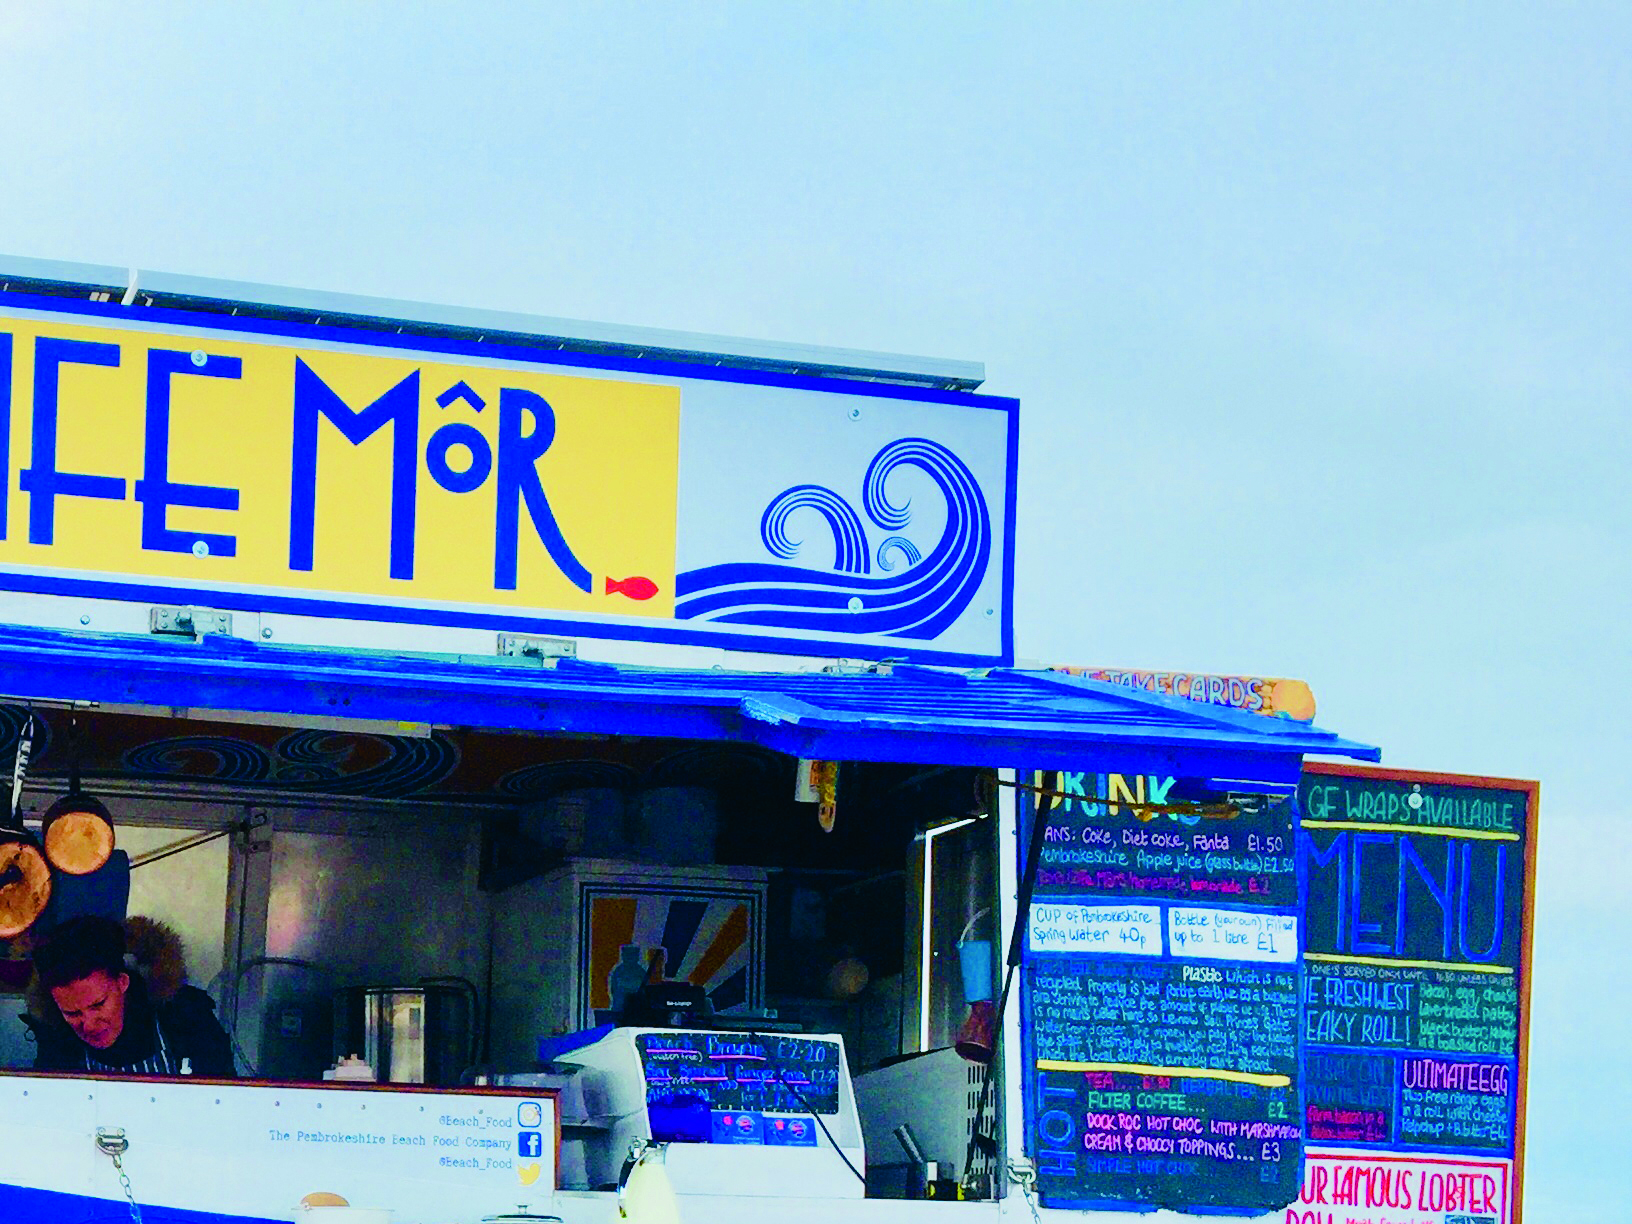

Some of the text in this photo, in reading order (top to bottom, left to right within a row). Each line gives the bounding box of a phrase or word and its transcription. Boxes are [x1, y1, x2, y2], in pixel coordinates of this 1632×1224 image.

[1173, 673, 1263, 710] CARDS
[1308, 786, 1513, 829] GF WRAPS AVAILABLE
[1081, 828, 1117, 848] Coke,
[1123, 830, 1148, 846] Diet
[1193, 834, 1229, 850] Fanta
[1247, 834, 1283, 852] £1.50
[1136, 852, 1202, 872] Apple juice
[1037, 911, 1061, 923] CUP
[1257, 932, 1278, 953] £1
[1361, 1014, 1411, 1045] ROLL!
[1088, 1091, 1288, 1118] FILTER £2
[439, 1115, 513, 1129] @Beach_Food
[1037, 1072, 1077, 1177] HOT
[1147, 1114, 1237, 1136] HOT CHOC WITH
[268, 1130, 512, 1151] The Pembrokeshire Beach Food Company
[1084, 1133, 1281, 1162] CREAM £3
[439, 1157, 513, 1170] @Beach_Food
[1332, 1165, 1413, 1210] FAMOUS
